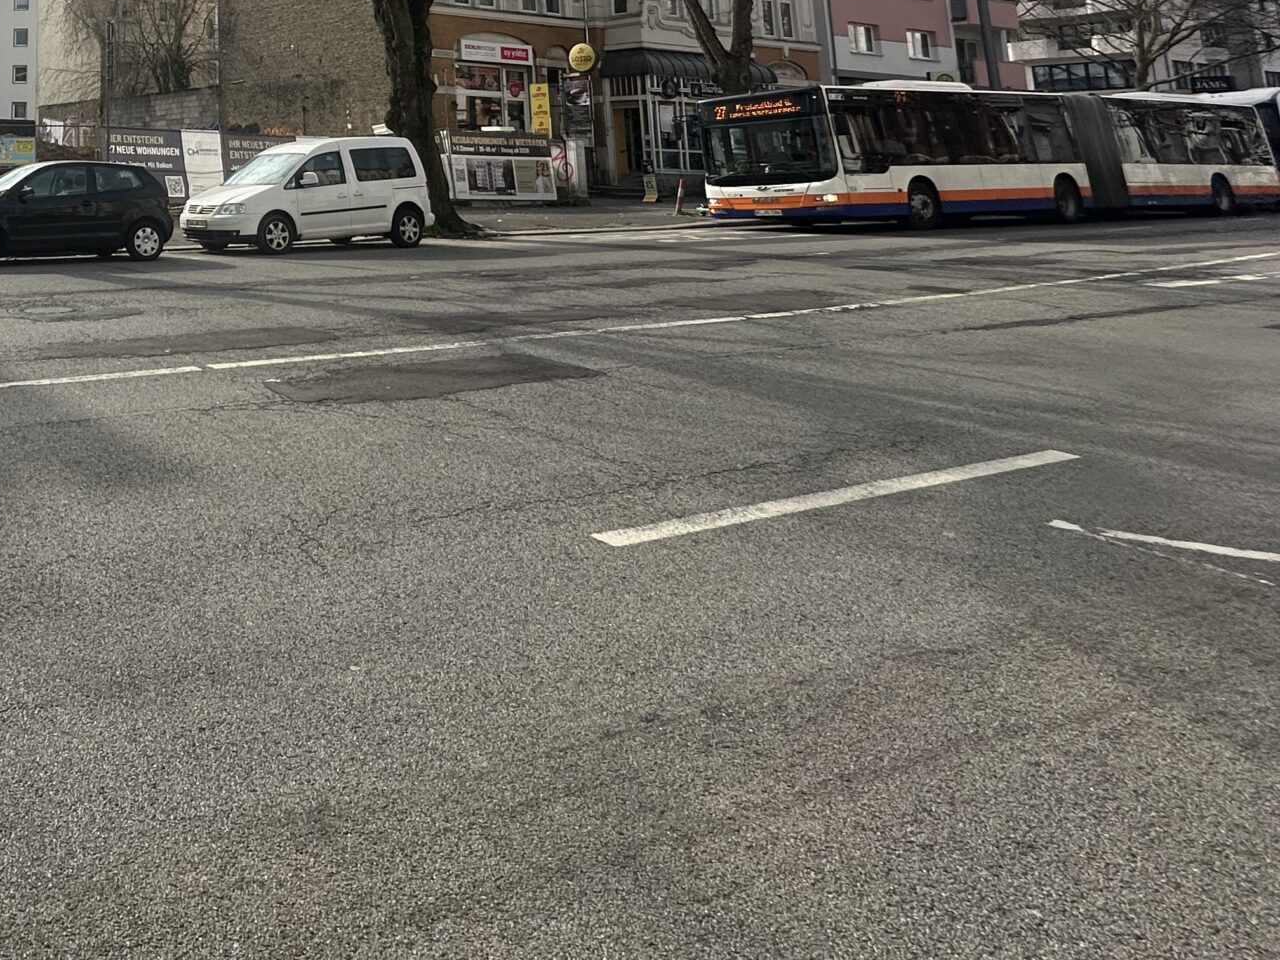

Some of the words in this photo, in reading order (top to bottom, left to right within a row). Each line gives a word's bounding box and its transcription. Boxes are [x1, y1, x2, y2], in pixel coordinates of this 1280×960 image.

[571, 55, 592, 63] LOTTO
[713, 105, 726, 120] 27
[123, 134, 164, 145] ENTSTEHEN
[229, 140, 241, 148] IHR
[241, 140, 264, 149] NEUES
[116, 145, 136, 155] NEUE
[136, 146, 180, 156] WOHNUNGEN
